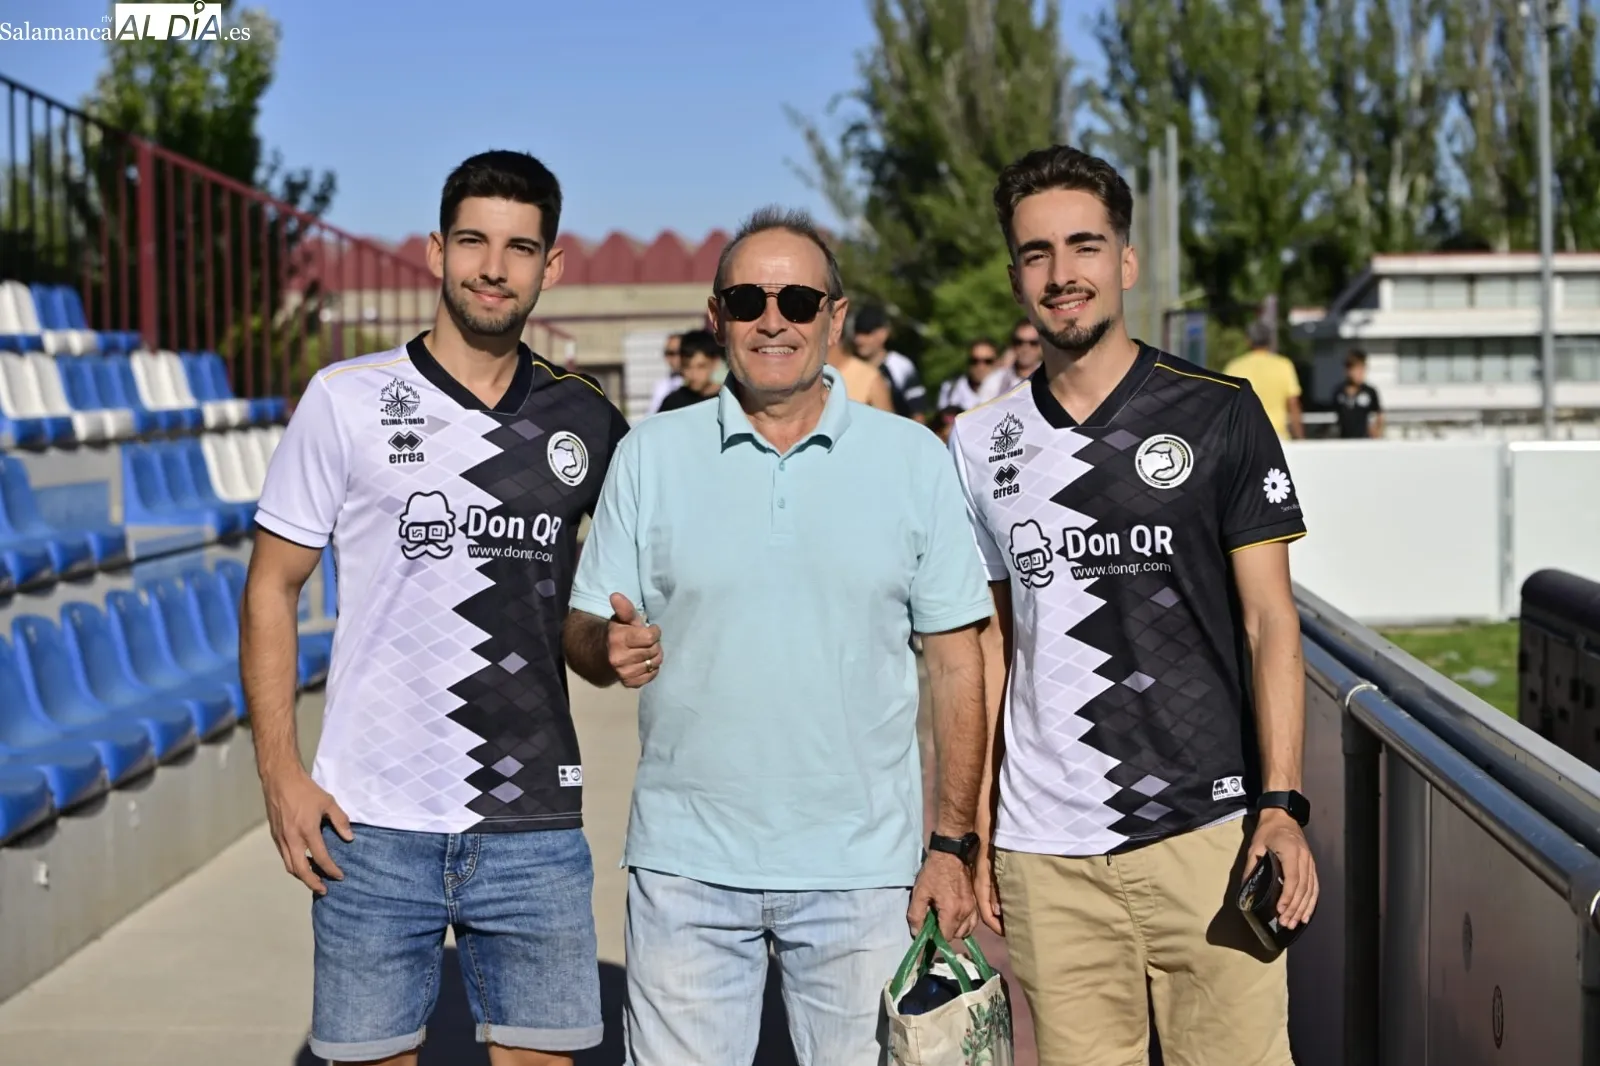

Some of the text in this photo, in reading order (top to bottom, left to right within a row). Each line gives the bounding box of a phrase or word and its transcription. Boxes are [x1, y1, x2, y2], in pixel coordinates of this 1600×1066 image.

[388, 452, 425, 464] errea
[993, 483, 1020, 500] errea
[467, 507, 525, 540] Don
[1064, 524, 1174, 560] Don QR
[1072, 562, 1172, 578] www.donqr.com
